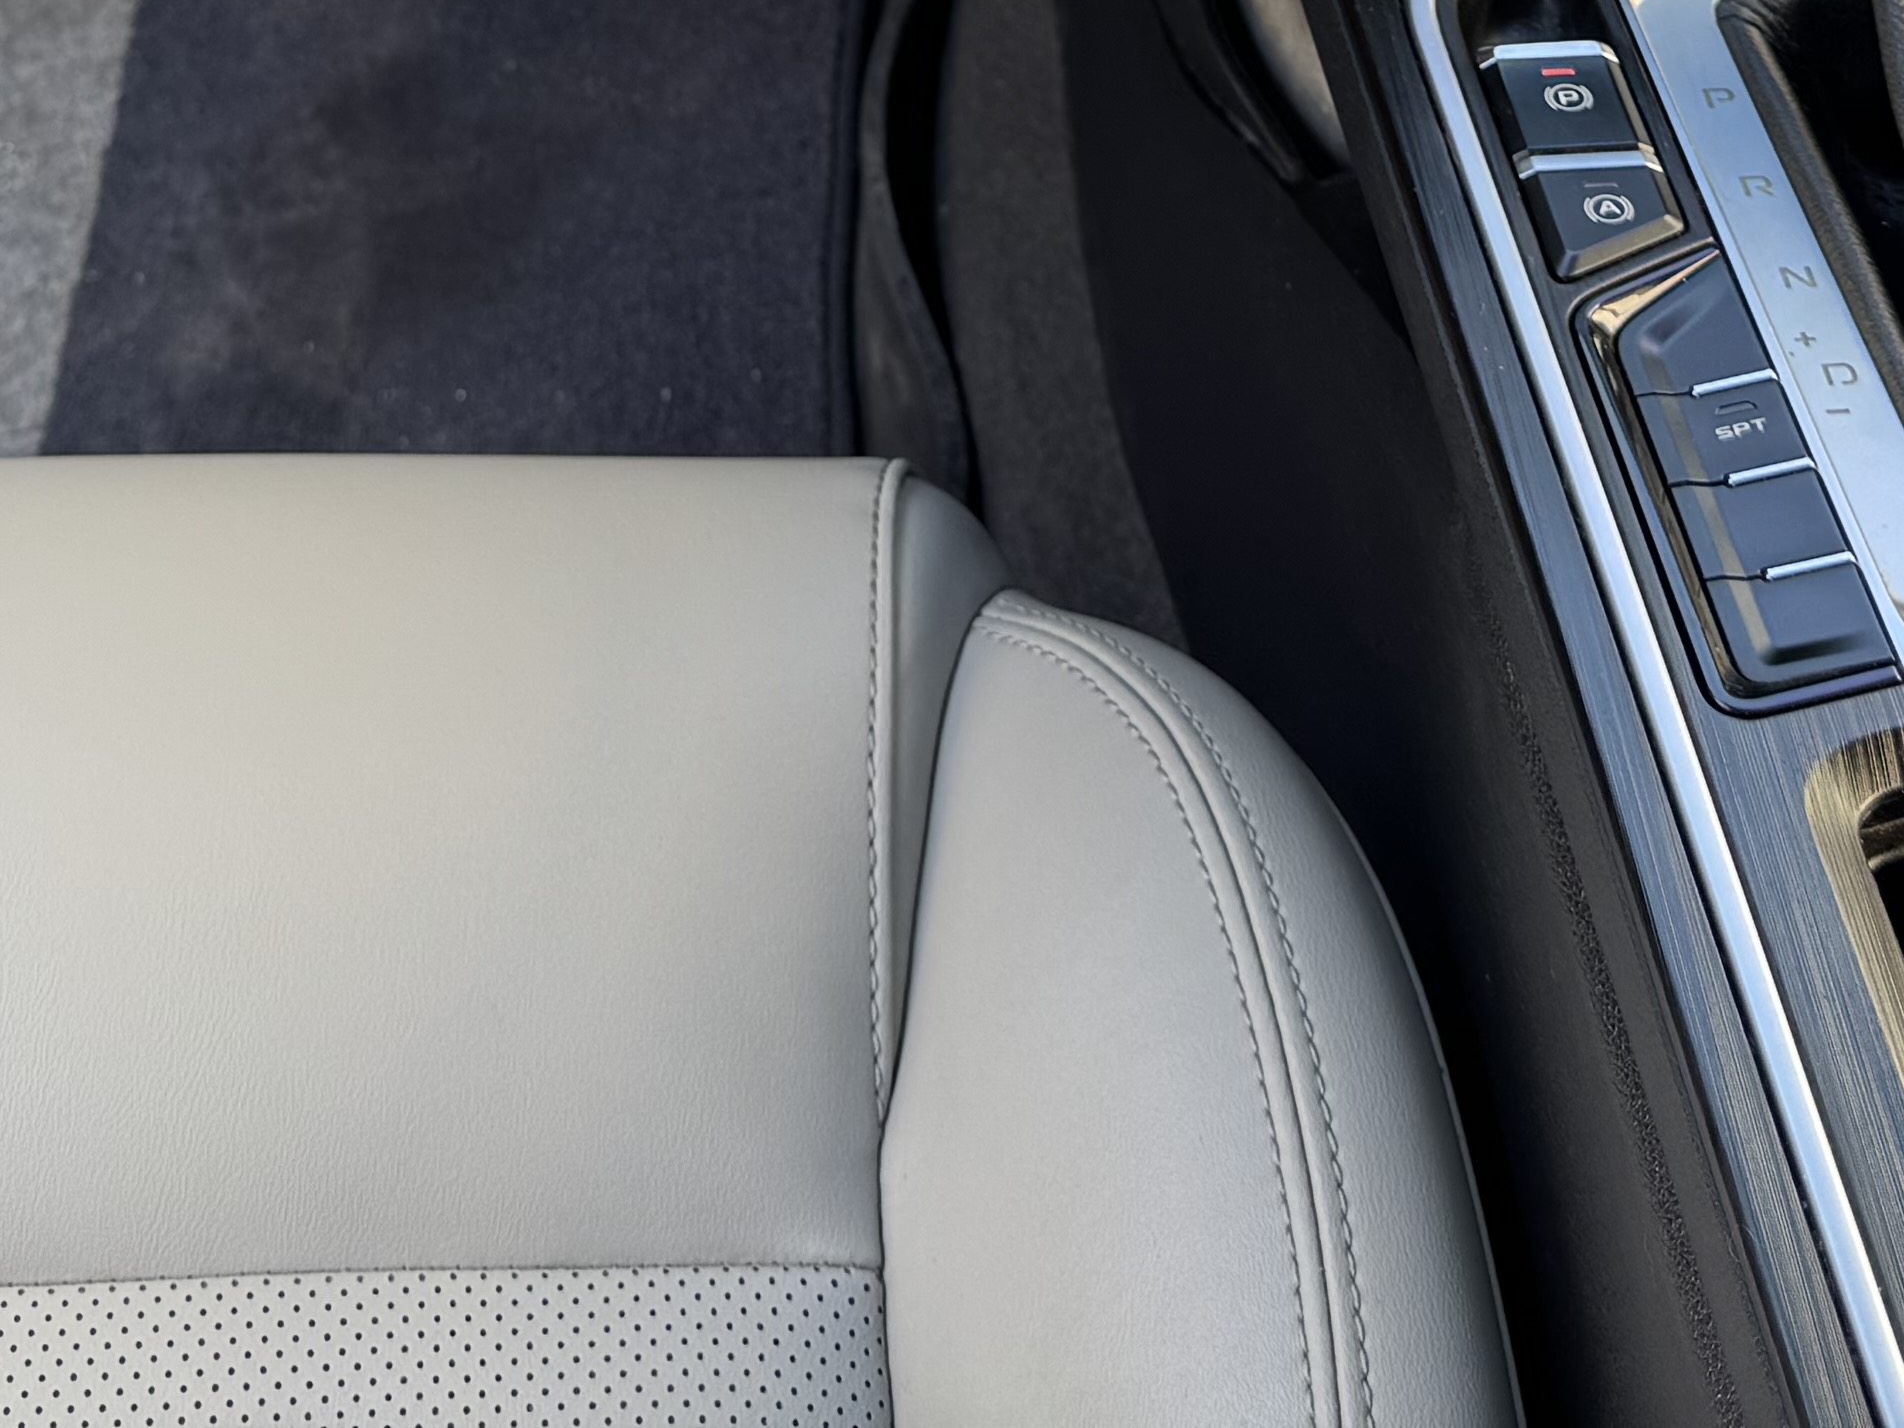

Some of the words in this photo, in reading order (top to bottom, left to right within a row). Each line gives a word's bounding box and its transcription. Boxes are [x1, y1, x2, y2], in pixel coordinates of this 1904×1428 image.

[1703, 88, 1735, 110] P
[1739, 175, 1774, 199] R
[1778, 266, 1817, 289] N
[1821, 363, 1858, 386] D
[1715, 417, 1766, 441] SPT
